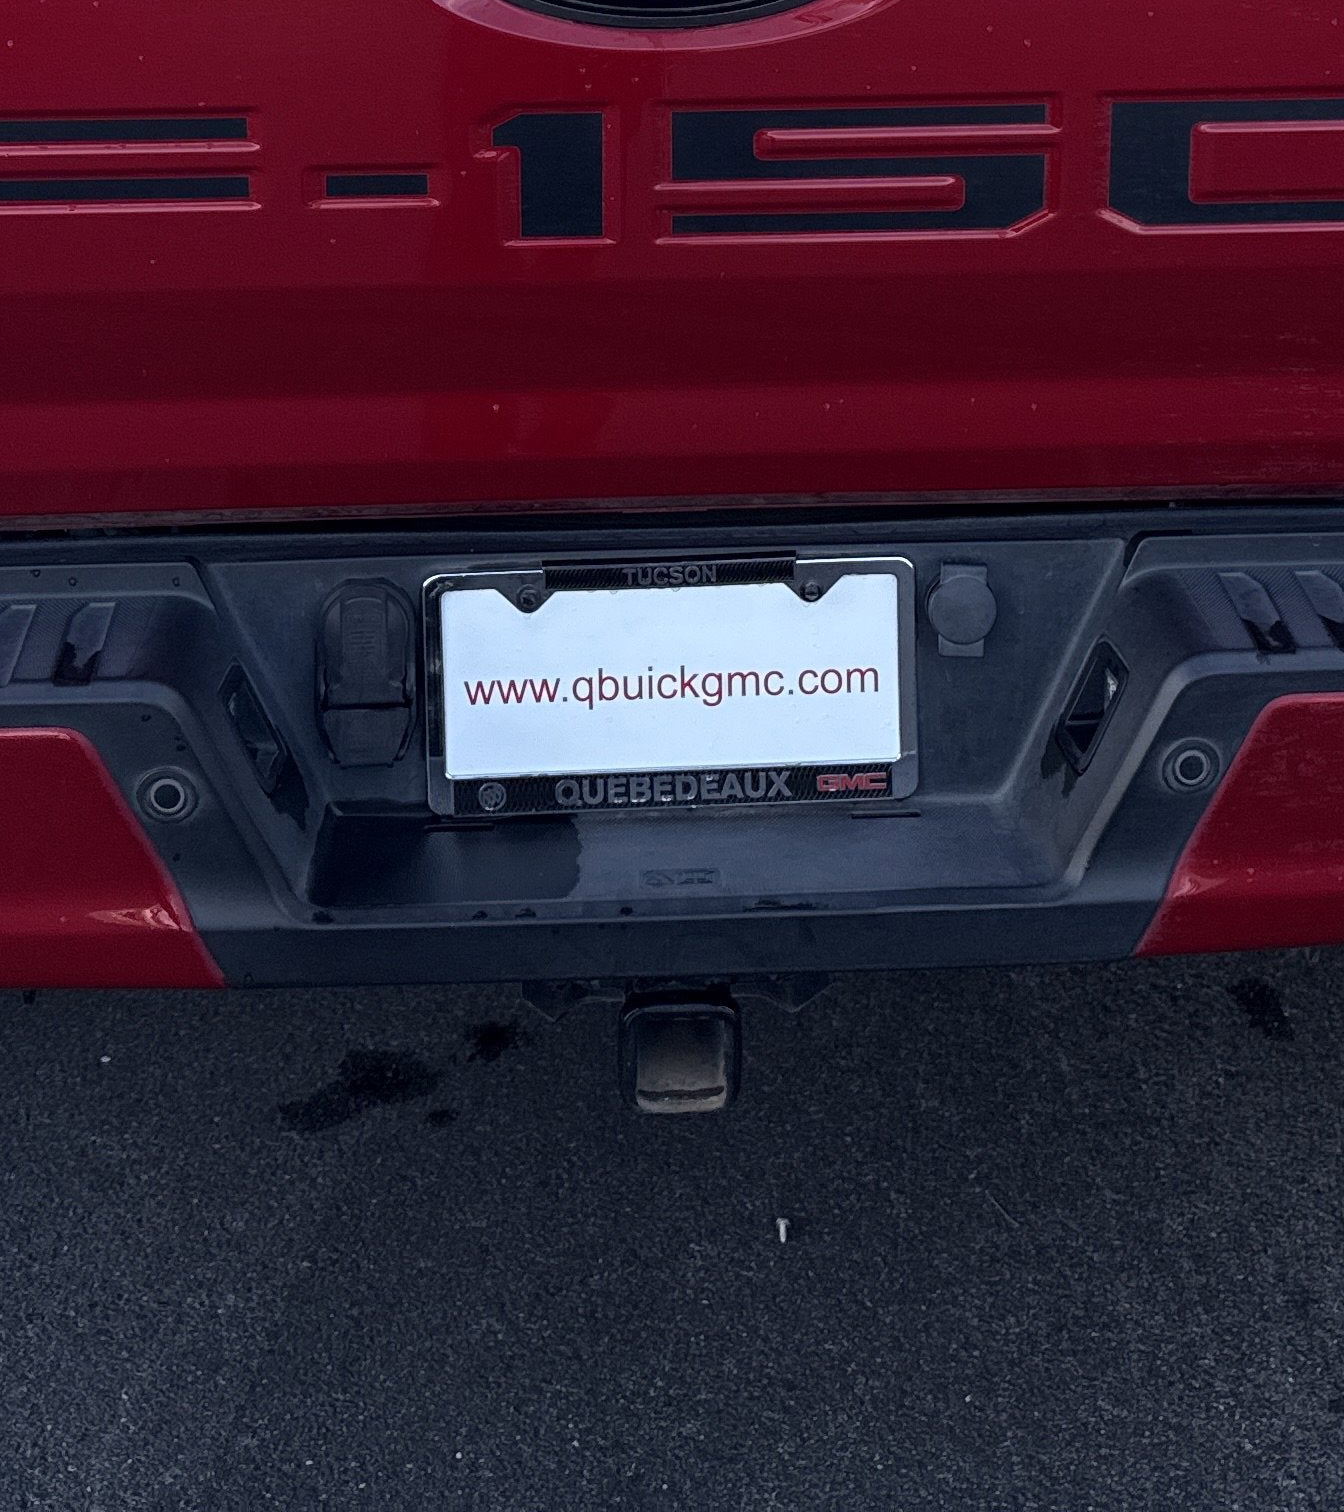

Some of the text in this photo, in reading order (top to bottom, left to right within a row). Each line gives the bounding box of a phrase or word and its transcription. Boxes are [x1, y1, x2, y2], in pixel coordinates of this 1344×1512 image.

[622, 565, 717, 586] TUCSON
[464, 665, 880, 710] www.qbuickgmc.com
[556, 771, 887, 806] QUEBEDEAUX GMC
